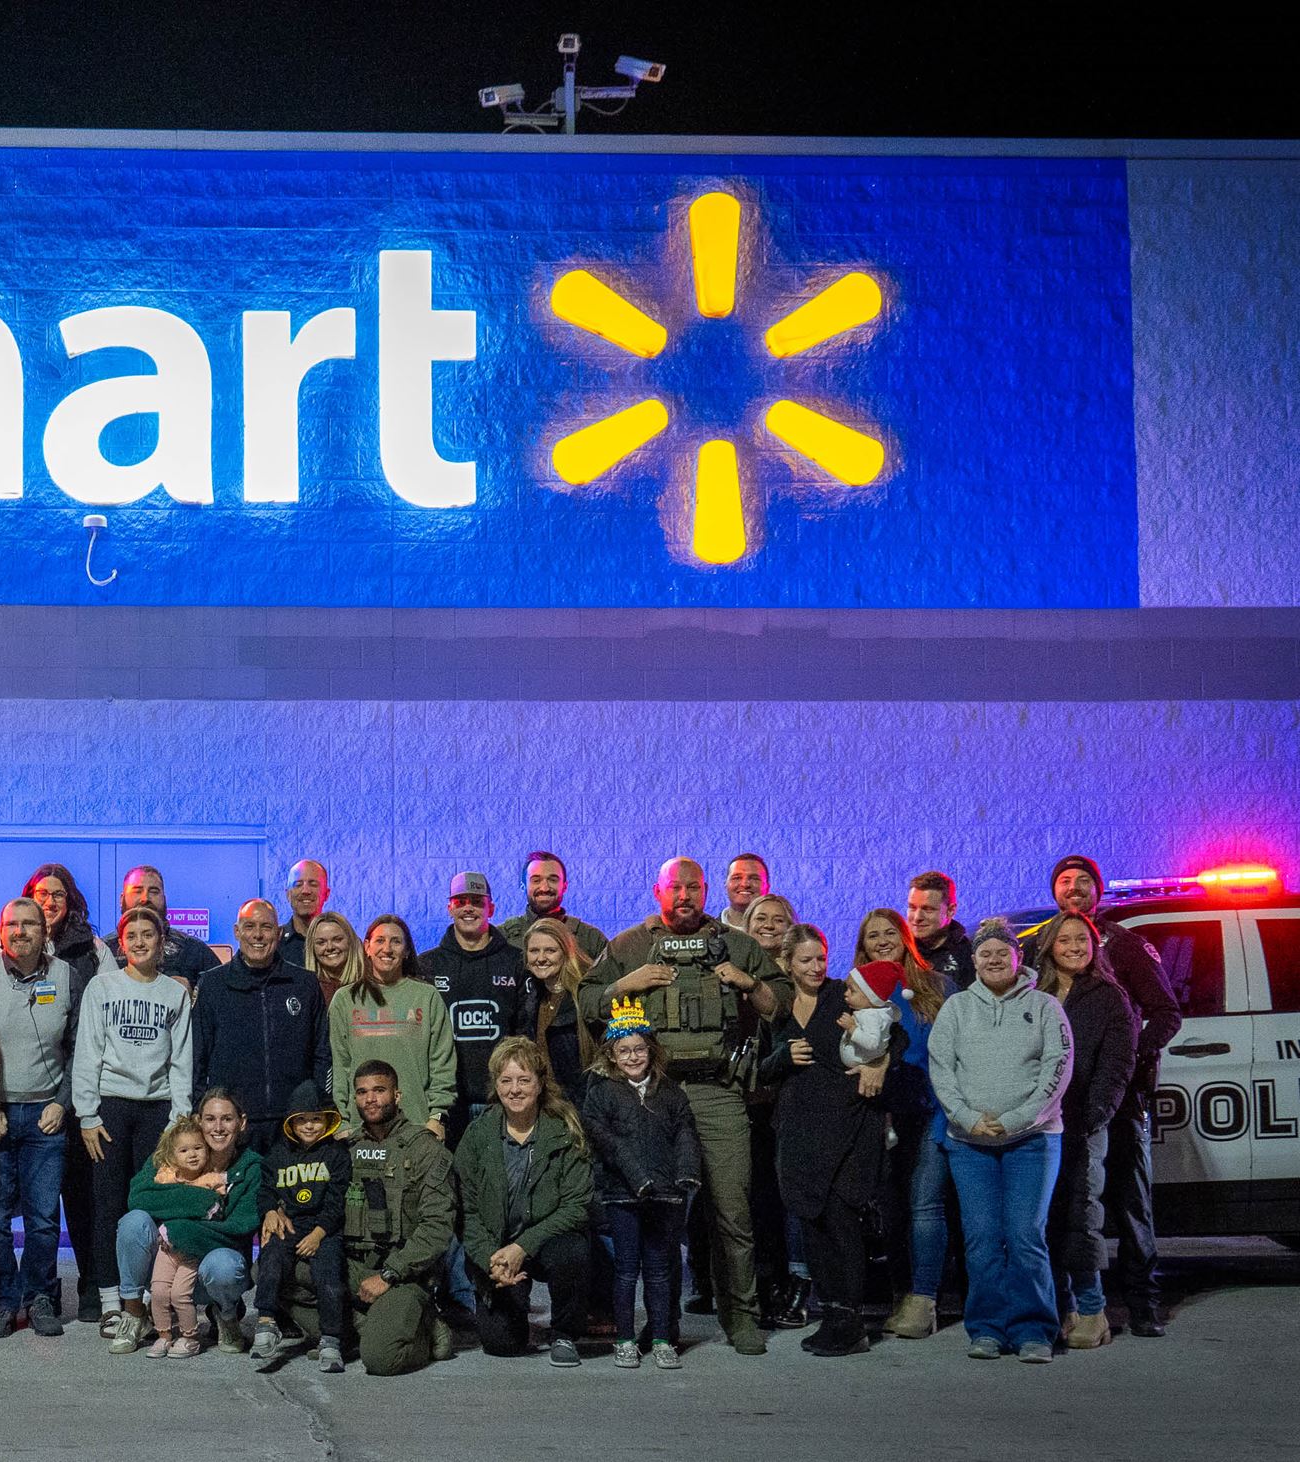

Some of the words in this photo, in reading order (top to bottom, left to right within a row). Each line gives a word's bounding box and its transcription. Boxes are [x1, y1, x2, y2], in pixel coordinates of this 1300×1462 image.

[173, 913, 186, 921] NOT
[187, 913, 208, 921] BLOCK
[187, 928, 208, 938] EXIT
[664, 939, 704, 951] POLICE
[492, 975, 517, 987] USA
[121, 1027, 156, 1038] FLORIDA
[1150, 1078, 1300, 1144] POL
[355, 1149, 387, 1160] POLICE
[276, 1161, 331, 1188] IOWA
